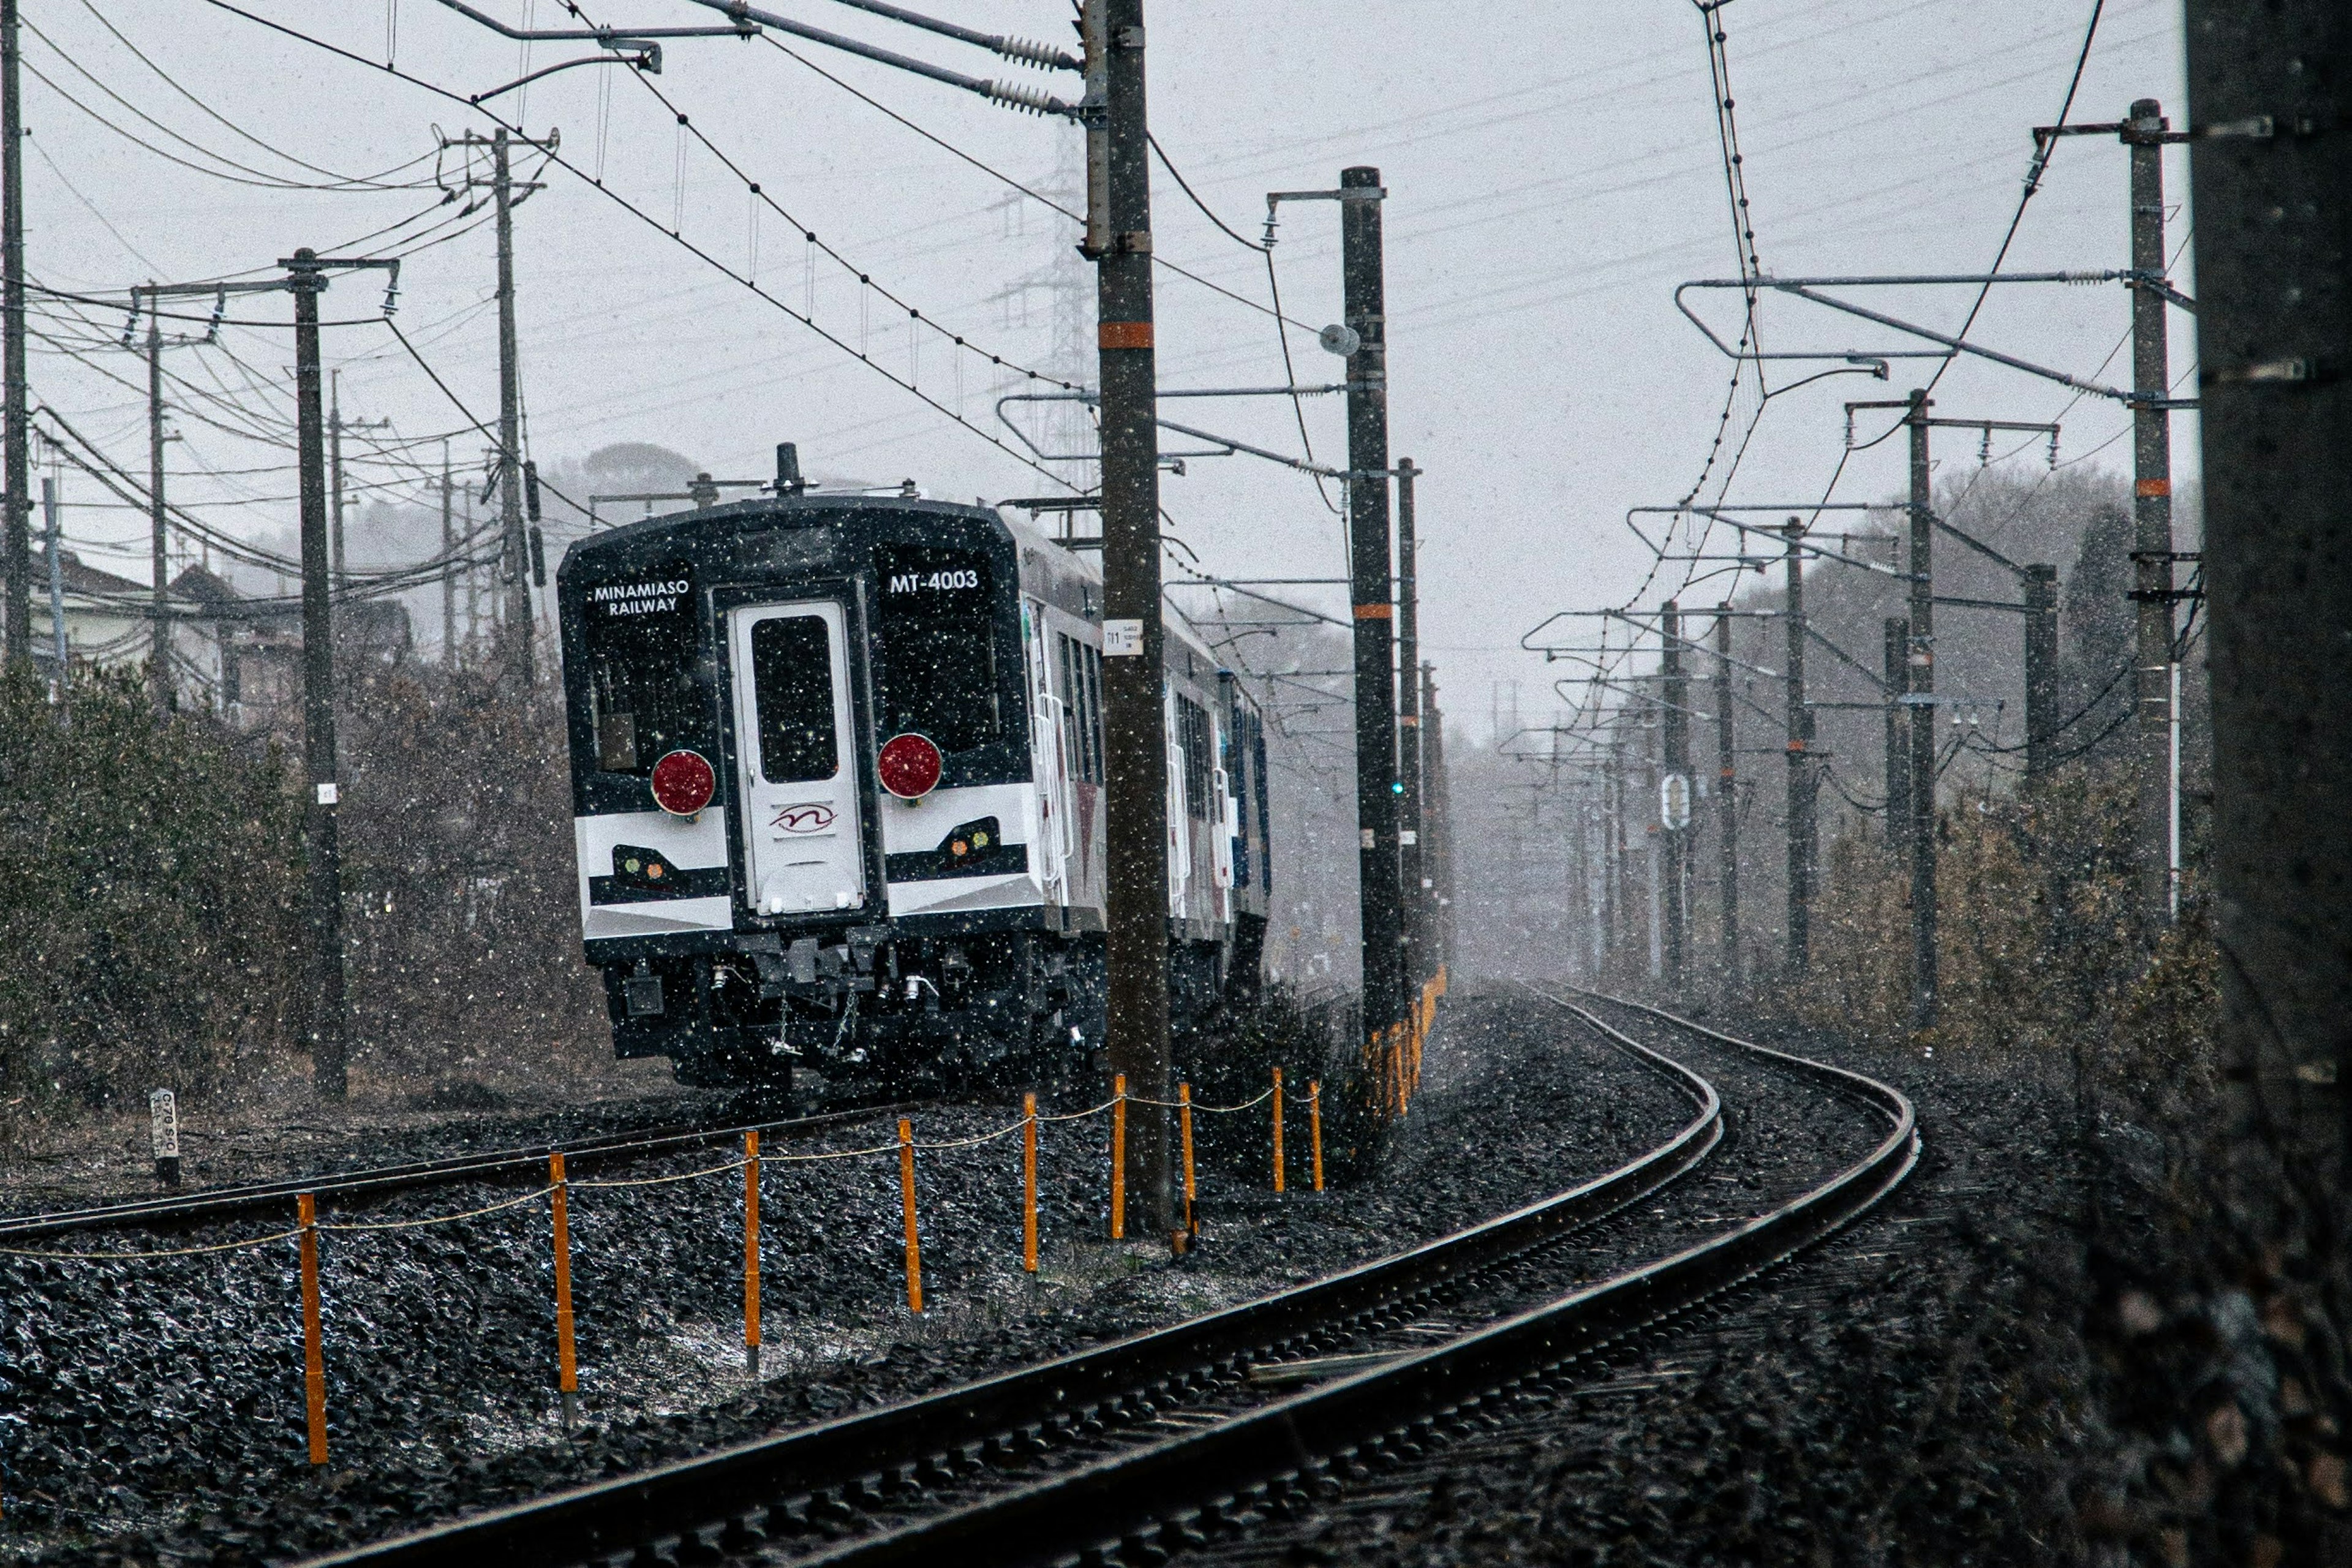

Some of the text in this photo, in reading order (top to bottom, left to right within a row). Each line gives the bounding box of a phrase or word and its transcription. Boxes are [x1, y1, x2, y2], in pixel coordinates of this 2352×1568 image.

[595, 580, 689, 603] MINAMIASO
[890, 570, 978, 594] MT-4003
[609, 598, 677, 616] RAILWAY
